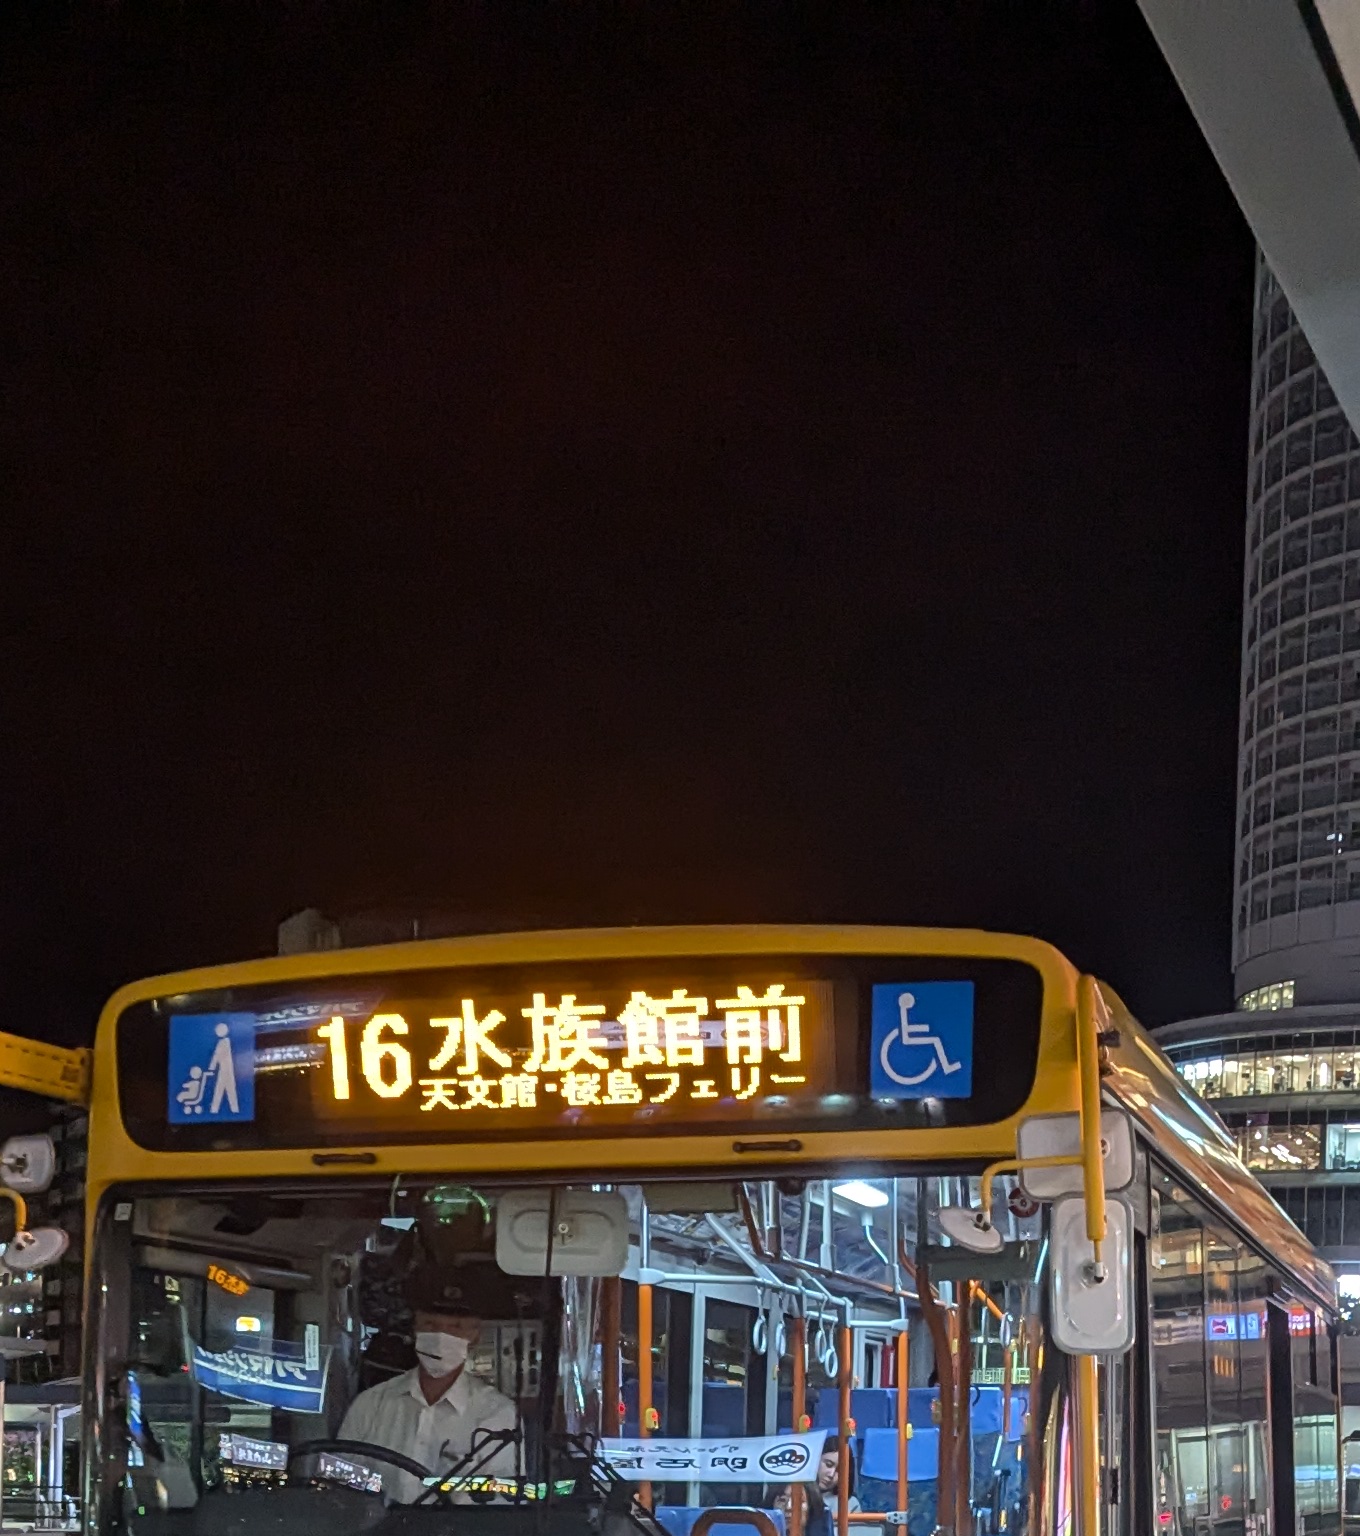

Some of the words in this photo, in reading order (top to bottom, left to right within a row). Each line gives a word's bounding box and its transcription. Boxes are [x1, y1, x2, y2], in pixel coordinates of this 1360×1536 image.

[317, 1013, 412, 1100] 16
[428, 984, 806, 1076] 水族館前
